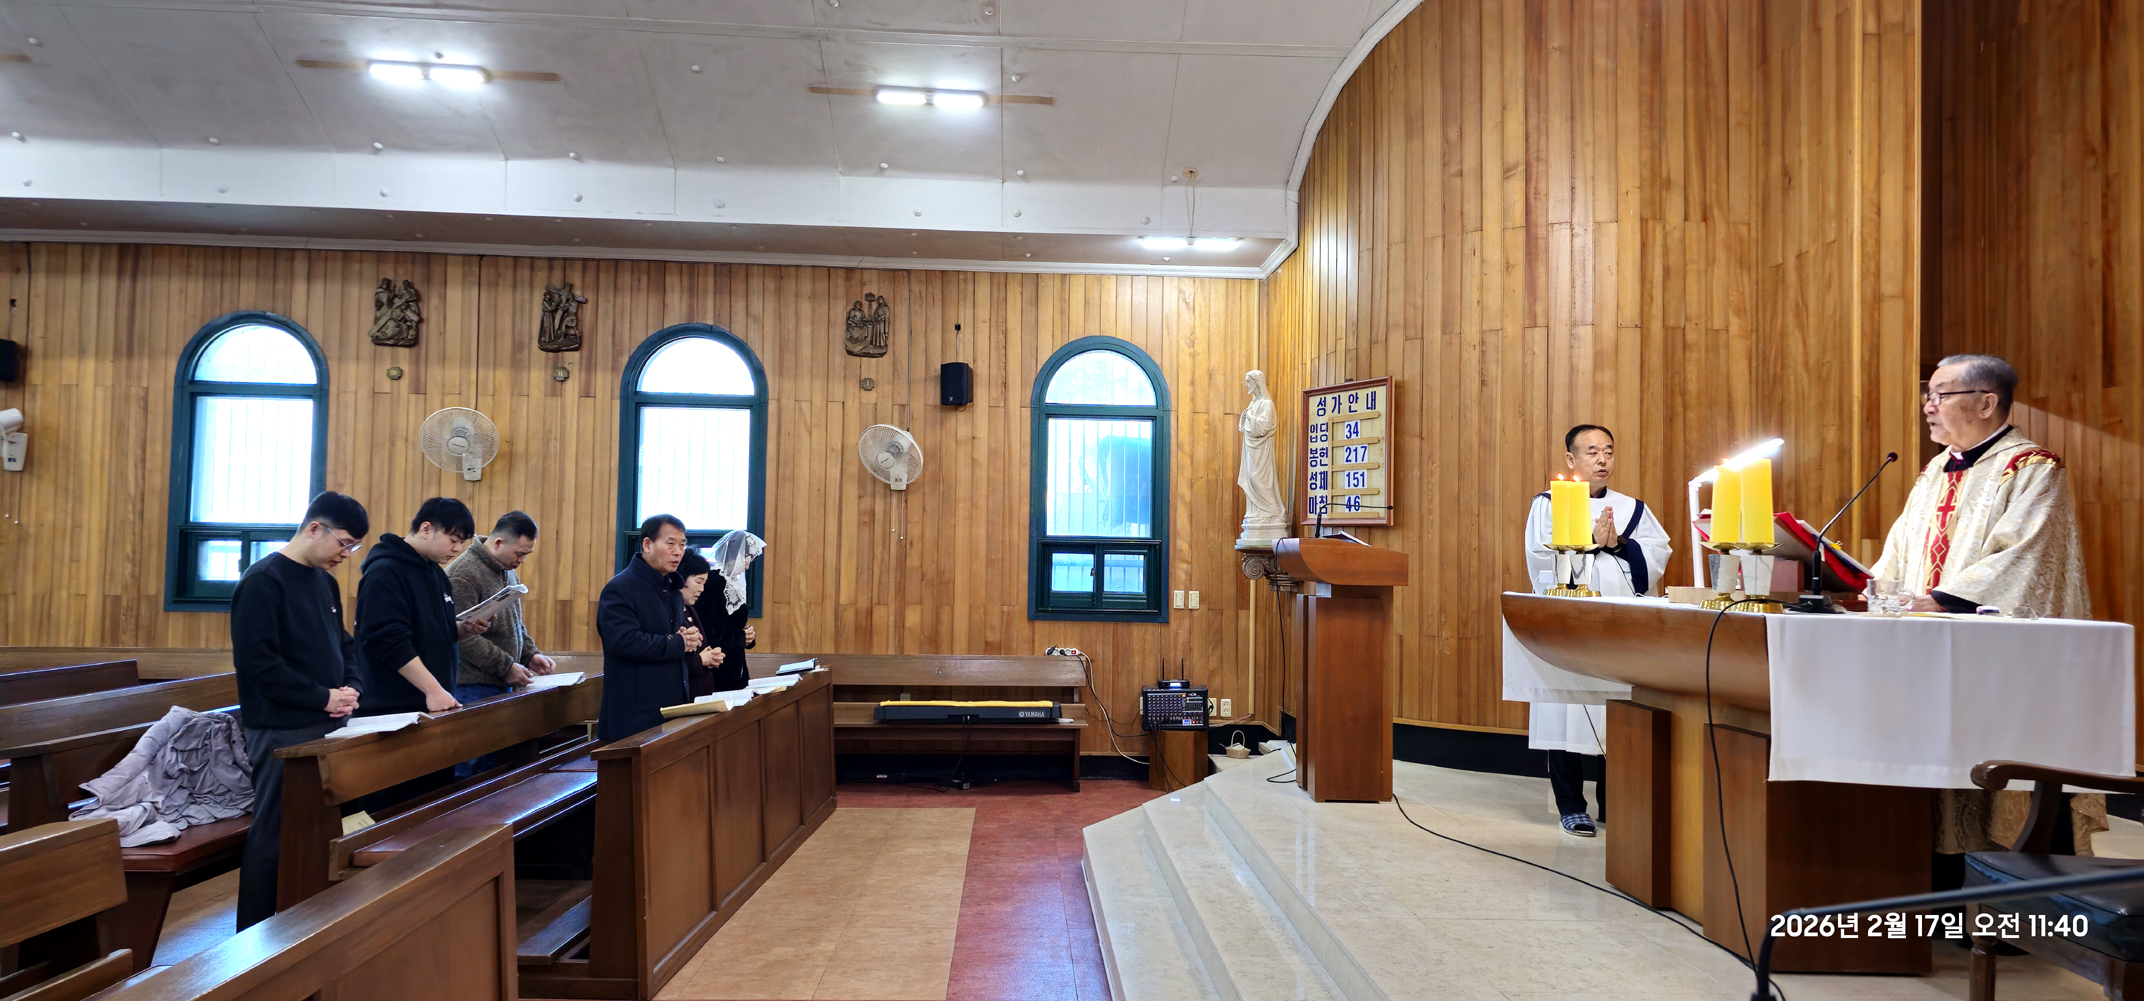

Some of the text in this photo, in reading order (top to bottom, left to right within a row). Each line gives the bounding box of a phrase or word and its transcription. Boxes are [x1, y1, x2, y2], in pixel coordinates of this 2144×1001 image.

[1345, 421, 1360, 439] 34
[1309, 445, 1368, 468] 봉헌 217
[1309, 471, 1366, 490] 성체 151
[1308, 495, 1361, 515] 마침 46
